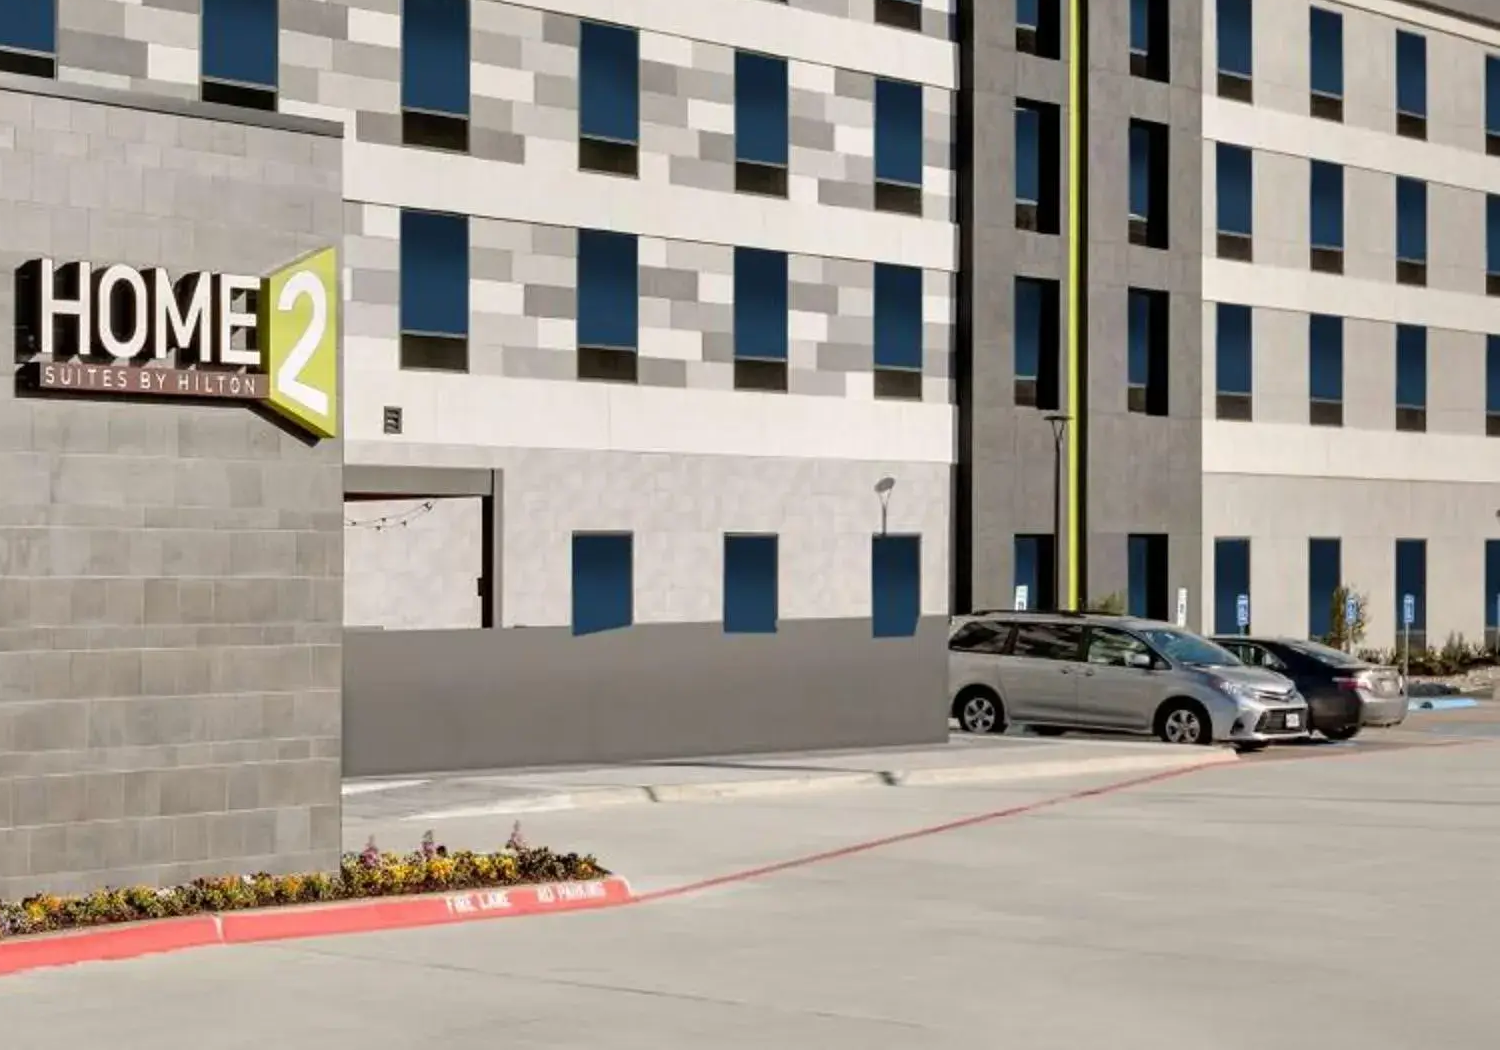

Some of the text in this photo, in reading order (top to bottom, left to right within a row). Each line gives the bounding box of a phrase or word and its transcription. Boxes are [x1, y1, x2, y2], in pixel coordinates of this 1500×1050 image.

[44, 366, 257, 396] SUITES BY HILTON
